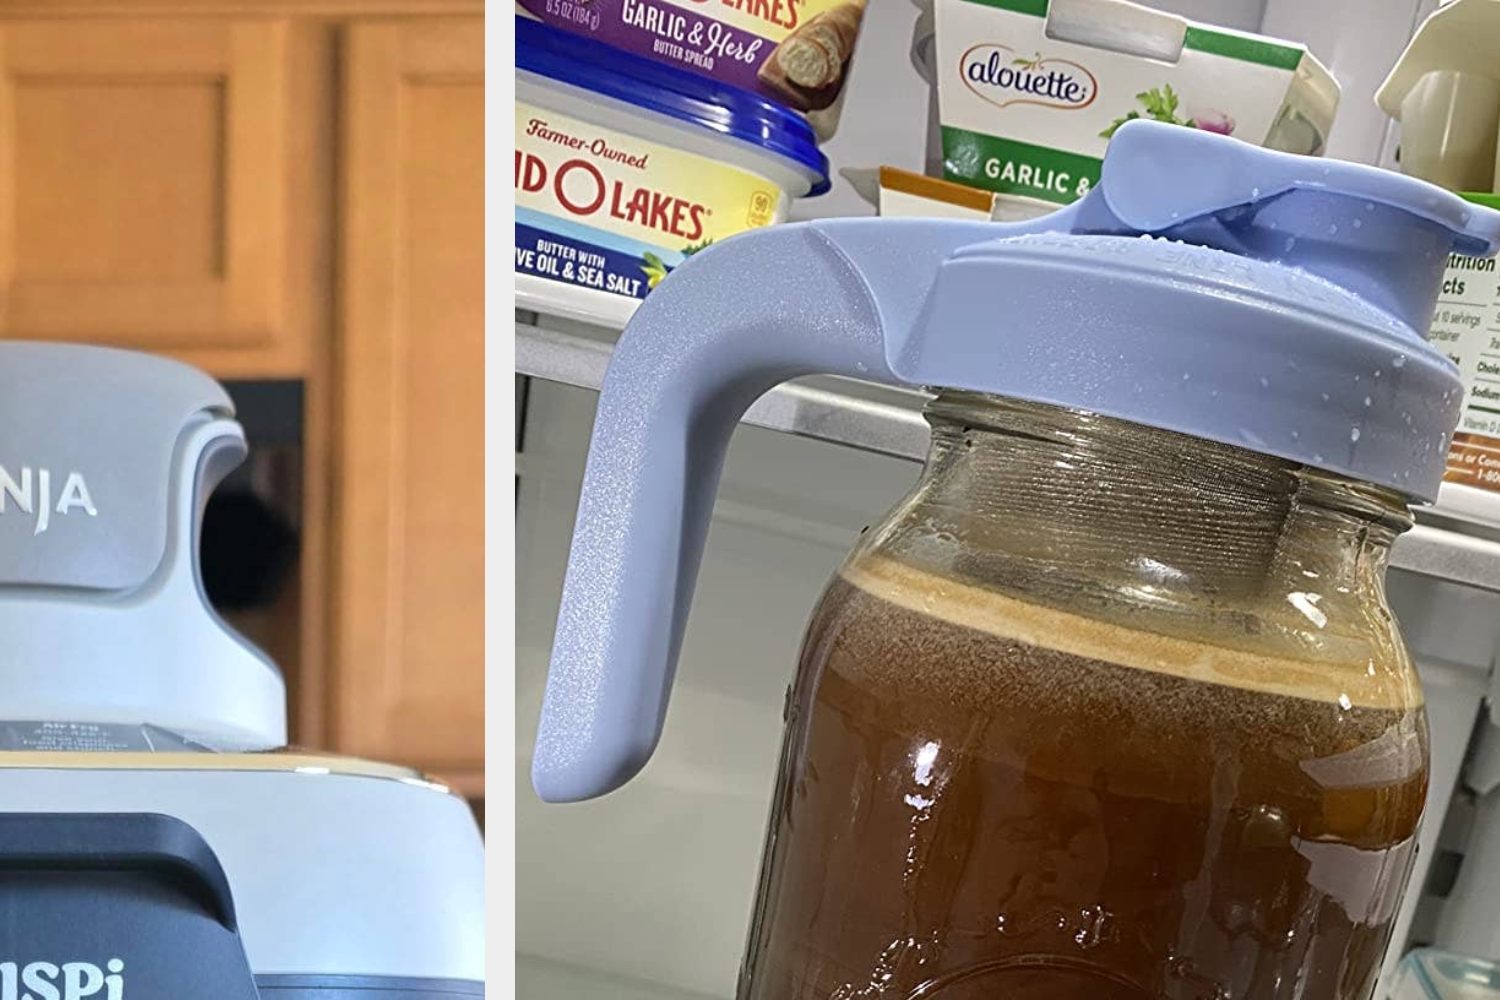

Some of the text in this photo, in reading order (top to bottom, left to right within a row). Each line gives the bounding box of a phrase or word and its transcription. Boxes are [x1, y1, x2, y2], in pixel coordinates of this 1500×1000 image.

[622, 0, 763, 64] GARLIC & Herb
[653, 38, 714, 71] BUTTER SPREAD
[968, 51, 1085, 103] alouette
[526, 118, 650, 171] Farmer-Owned
[554, 159, 606, 216] O
[610, 180, 705, 241] LAKES
[985, 158, 1091, 196] GARLIC &
[536, 253, 560, 276] OIL
[562, 262, 576, 280] &
[577, 265, 604, 287] SEA
[606, 273, 642, 298] SALT
[537, 238, 606, 269] BUTTER WITH
